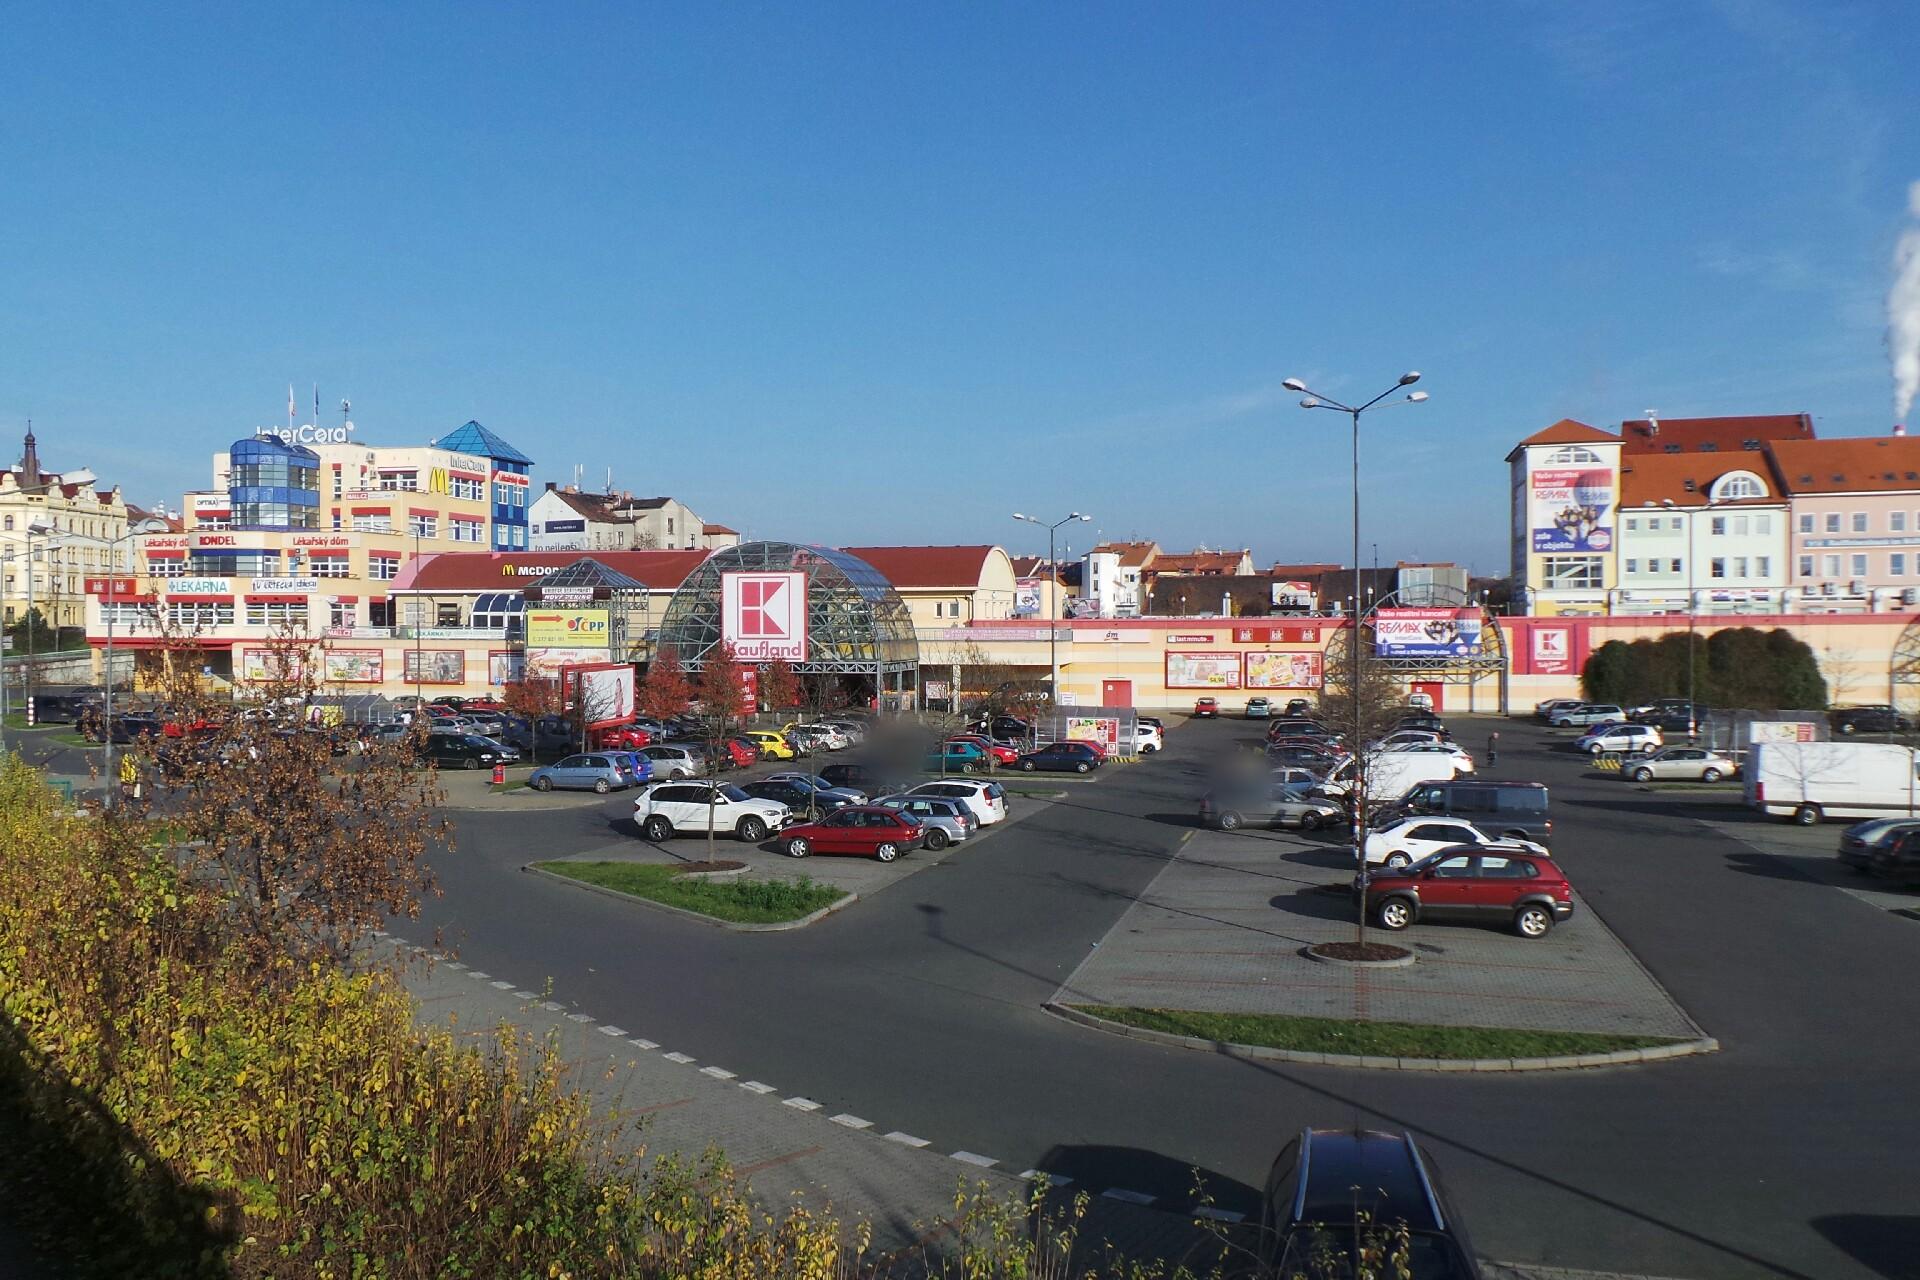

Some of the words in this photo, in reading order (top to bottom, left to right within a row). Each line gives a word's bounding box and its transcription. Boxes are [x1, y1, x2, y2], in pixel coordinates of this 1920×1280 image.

[450, 455, 486, 472] InterCora
[293, 537, 328, 547] Lékařský
[330, 536, 349, 546] dům
[581, 618, 605, 632] ČPP
[727, 641, 802, 658] Kaufland
